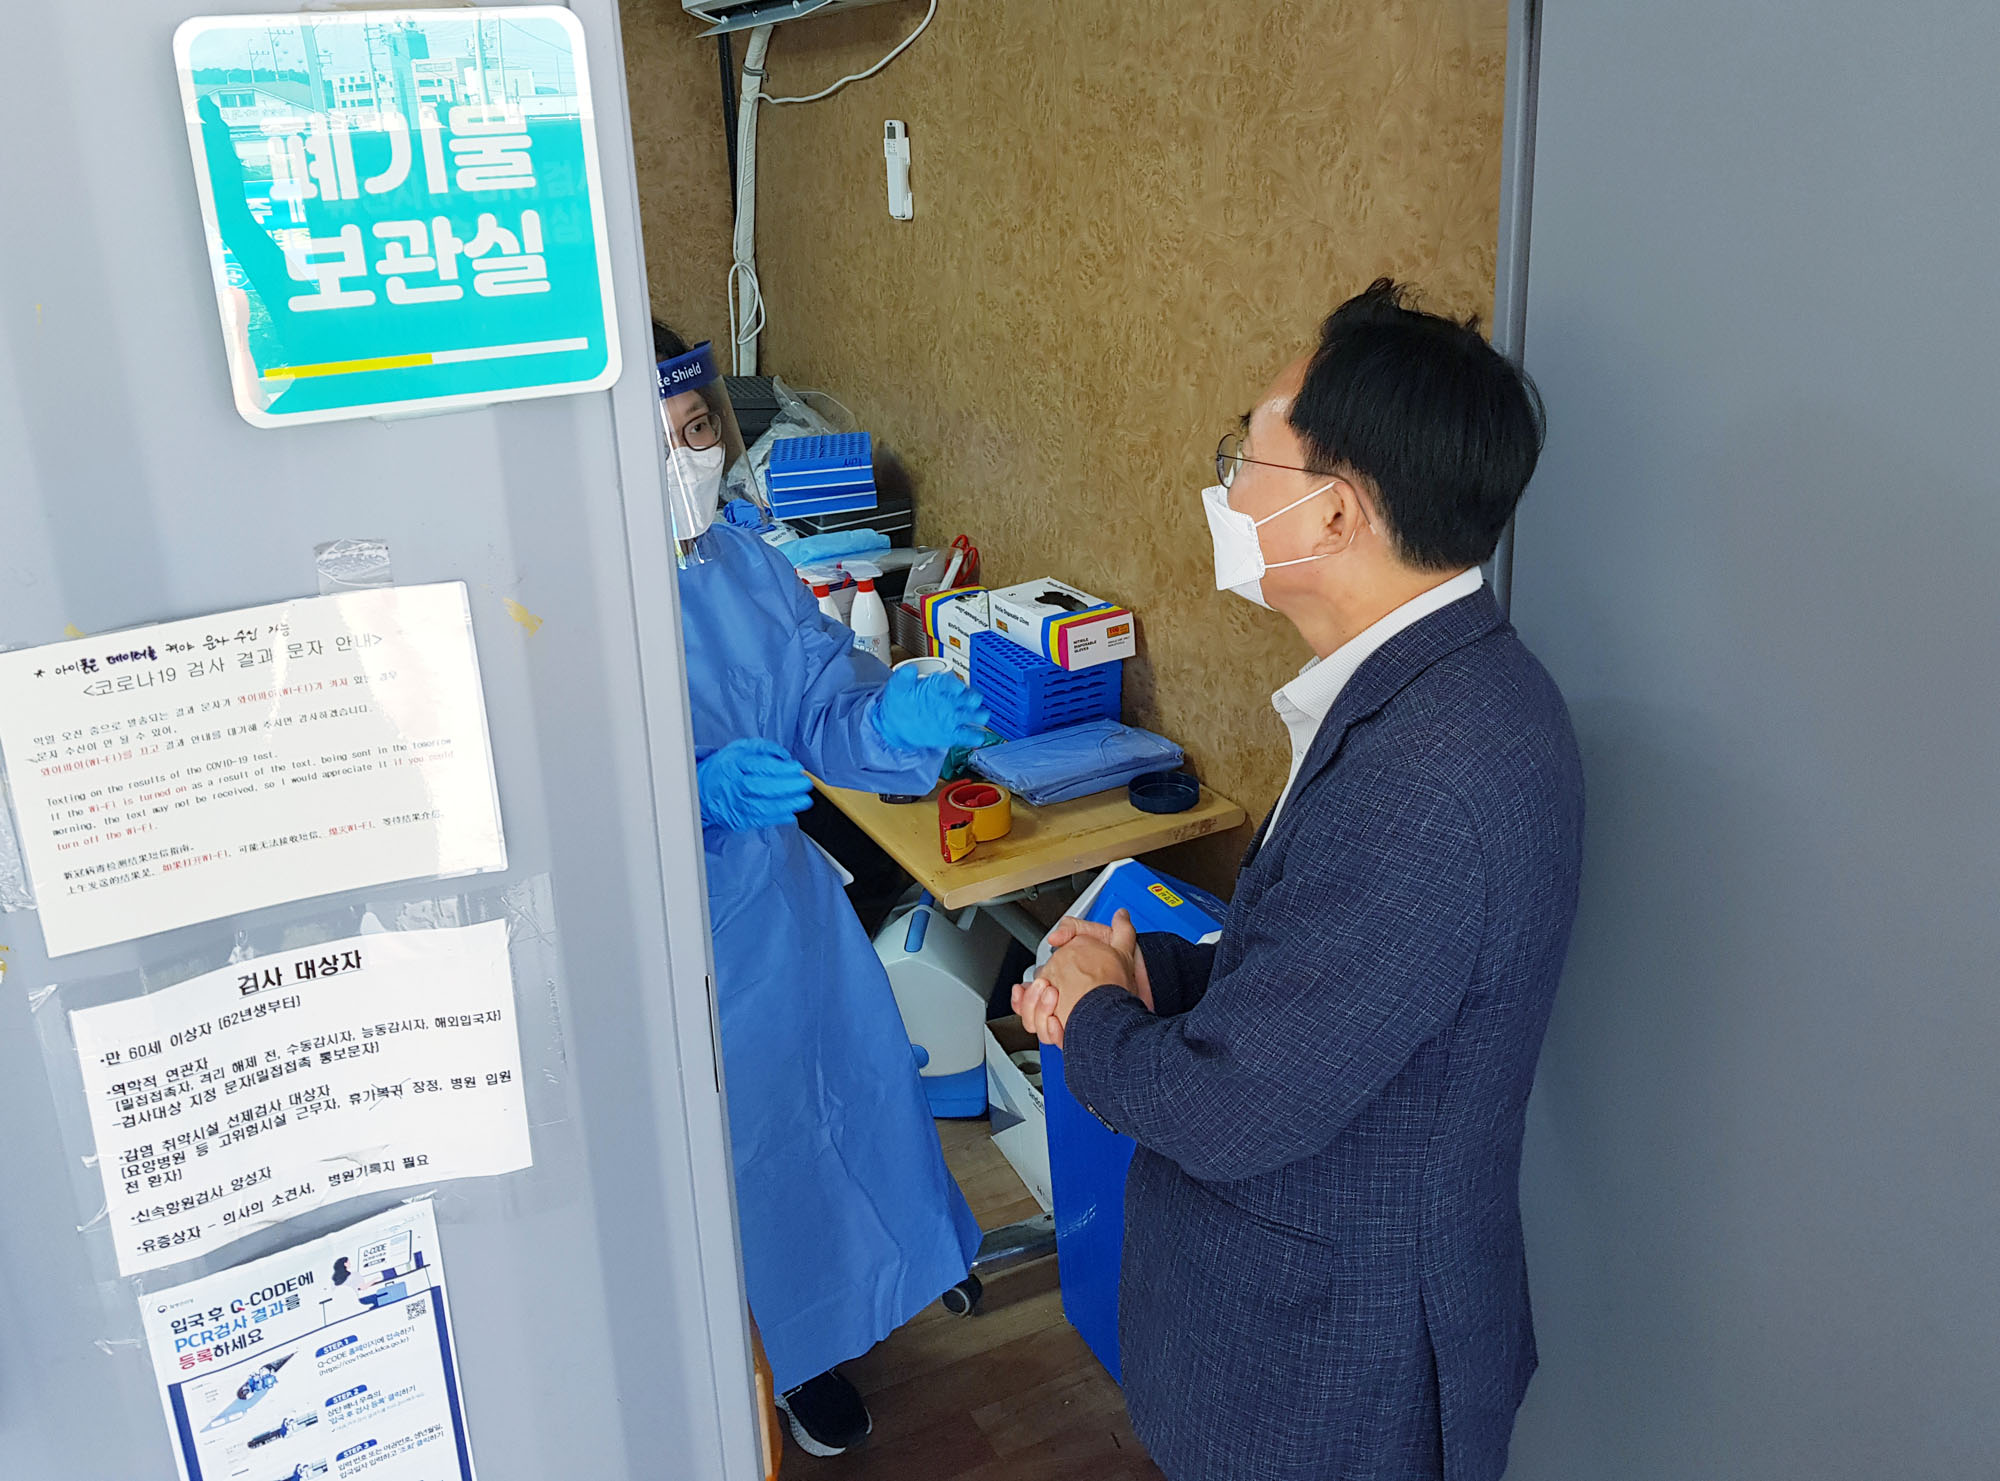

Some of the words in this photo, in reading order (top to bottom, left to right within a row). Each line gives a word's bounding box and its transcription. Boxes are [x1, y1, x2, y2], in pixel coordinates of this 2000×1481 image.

[260, 104, 536, 202] 폐기물
[284, 209, 551, 312] 보관실
[672, 362, 702, 383] Shield
[1073, 640, 1097, 649] DISPOSABLE
[82, 666, 176, 696] <코로나19
[186, 656, 224, 677] 검사
[236, 648, 273, 668] 결과
[288, 640, 323, 659] 문자
[336, 634, 382, 651] 안내>
[176, 706, 194, 717] 결과
[166, 738, 184, 750] 결과
[68, 810, 83, 818] the
[122, 798, 134, 806] is
[140, 788, 171, 802] turned
[192, 782, 203, 790] as
[218, 770, 248, 784] result
[254, 768, 264, 776] of
[270, 764, 286, 773] the
[320, 754, 347, 764] being
[352, 748, 371, 758] sent
[378, 746, 388, 754] in
[392, 744, 407, 752] the
[104, 816, 119, 825] the
[126, 808, 146, 820] text
[152, 804, 168, 814] may
[174, 798, 189, 808] not
[290, 772, 317, 783] would
[322, 764, 372, 778] appreciate
[378, 760, 387, 768] it
[394, 758, 402, 766] if
[108, 786, 123, 794] the
[128, 776, 166, 789] results
[170, 770, 180, 779] of
[186, 766, 201, 775] the
[206, 756, 248, 771] COVID-19
[56, 840, 79, 851] turn
[84, 834, 99, 845] off
[106, 832, 121, 840] the
[238, 967, 283, 995] 검사
[296, 950, 363, 980] 대상자
[128, 1040, 162, 1060] 60세
[170, 1022, 212, 1047] 이상자
[166, 1057, 208, 1082] 연관자
[200, 1067, 225, 1084] 격리
[232, 1056, 257, 1073] 해제
[190, 1087, 217, 1108] 지정
[195, 1142, 209, 1157] 등
[219, 1114, 287, 1147] 고위험시설
[450, 1076, 477, 1090] 병원
[486, 1070, 511, 1085] 입원
[162, 1122, 219, 1151] 취약시설
[227, 1099, 282, 1128] 선제검사
[289, 1084, 330, 1106] 대상자
[125, 1180, 140, 1195] 전
[223, 1201, 264, 1226] 의사의
[328, 1160, 396, 1187] 병원기록지
[402, 1155, 429, 1169] 필요
[231, 1166, 271, 1191] 양성자
[171, 1313, 204, 1335] 입국
[208, 1307, 225, 1322] 후
[230, 1271, 314, 1314] Q-CODE에
[175, 1315, 247, 1353] PCR검사
[251, 1294, 301, 1324] 결과를
[180, 1328, 264, 1370] 등록하세요
[318, 1352, 347, 1368] Q-CODE
[324, 1341, 343, 1354] STEP
[333, 1391, 352, 1404] STEP
[343, 1446, 362, 1458] STEP
